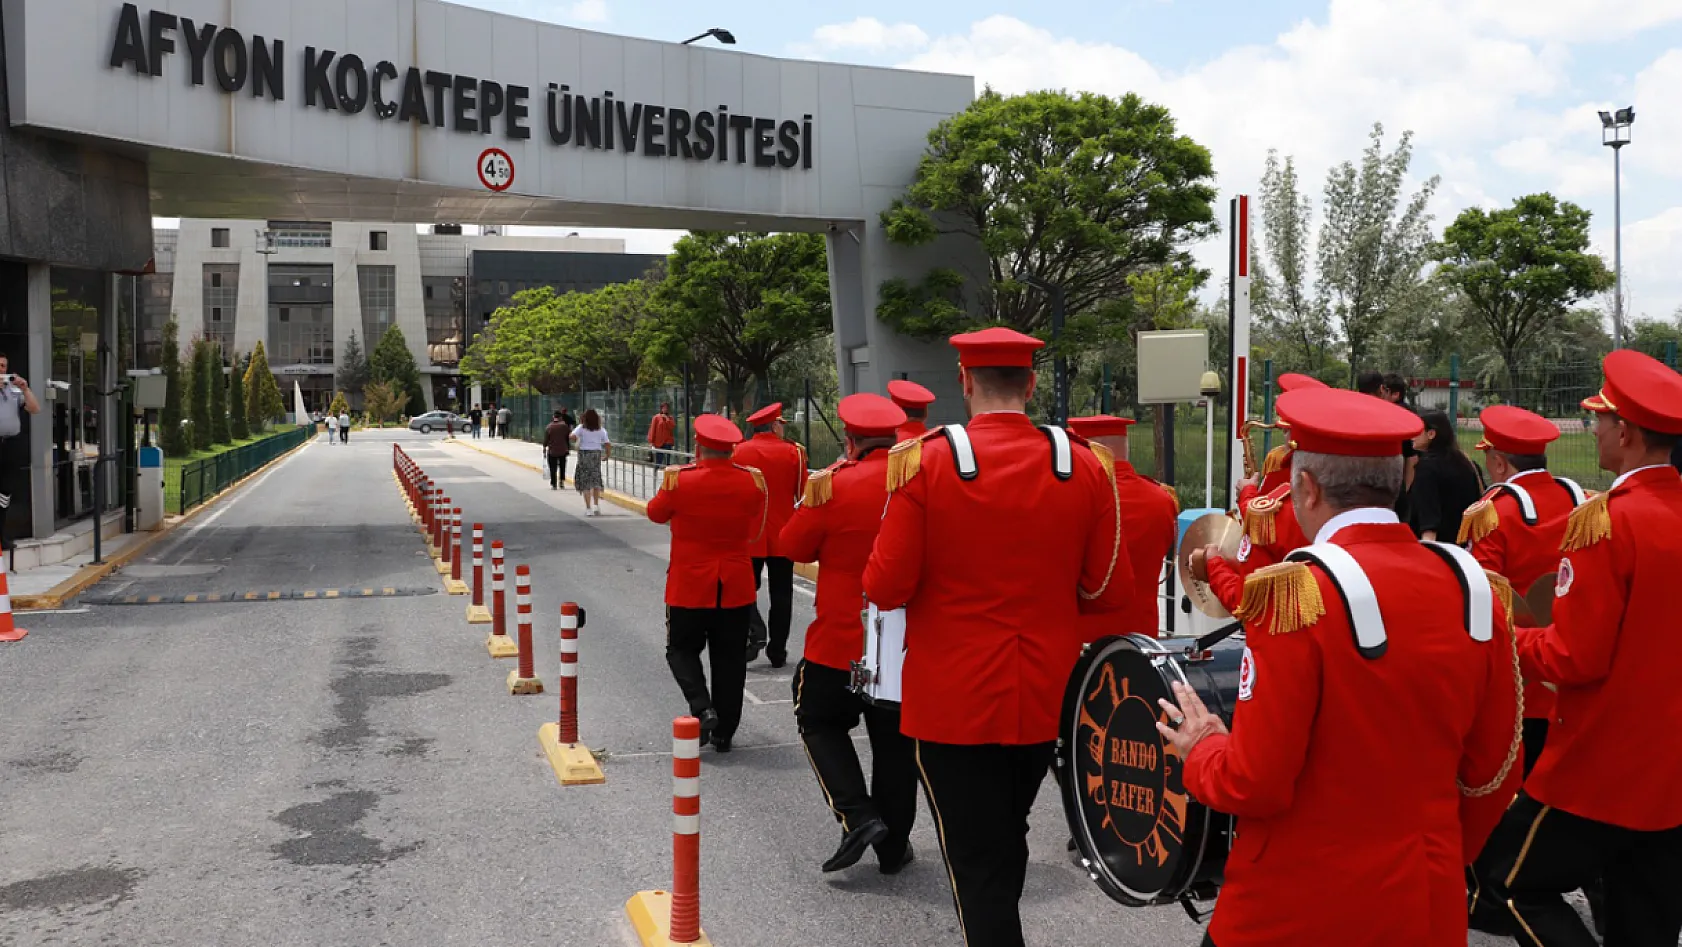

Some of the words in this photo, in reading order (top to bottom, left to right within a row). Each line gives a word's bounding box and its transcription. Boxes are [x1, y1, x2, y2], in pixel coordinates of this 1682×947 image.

[110, 2, 284, 101] AFYON
[304, 46, 530, 139] KOCATEPE
[546, 82, 813, 169] ÜNİVERSİTESİ
[485, 160, 496, 178] 4
[1111, 736, 1157, 771] BANDO
[1111, 780, 1155, 816] ZAFER
